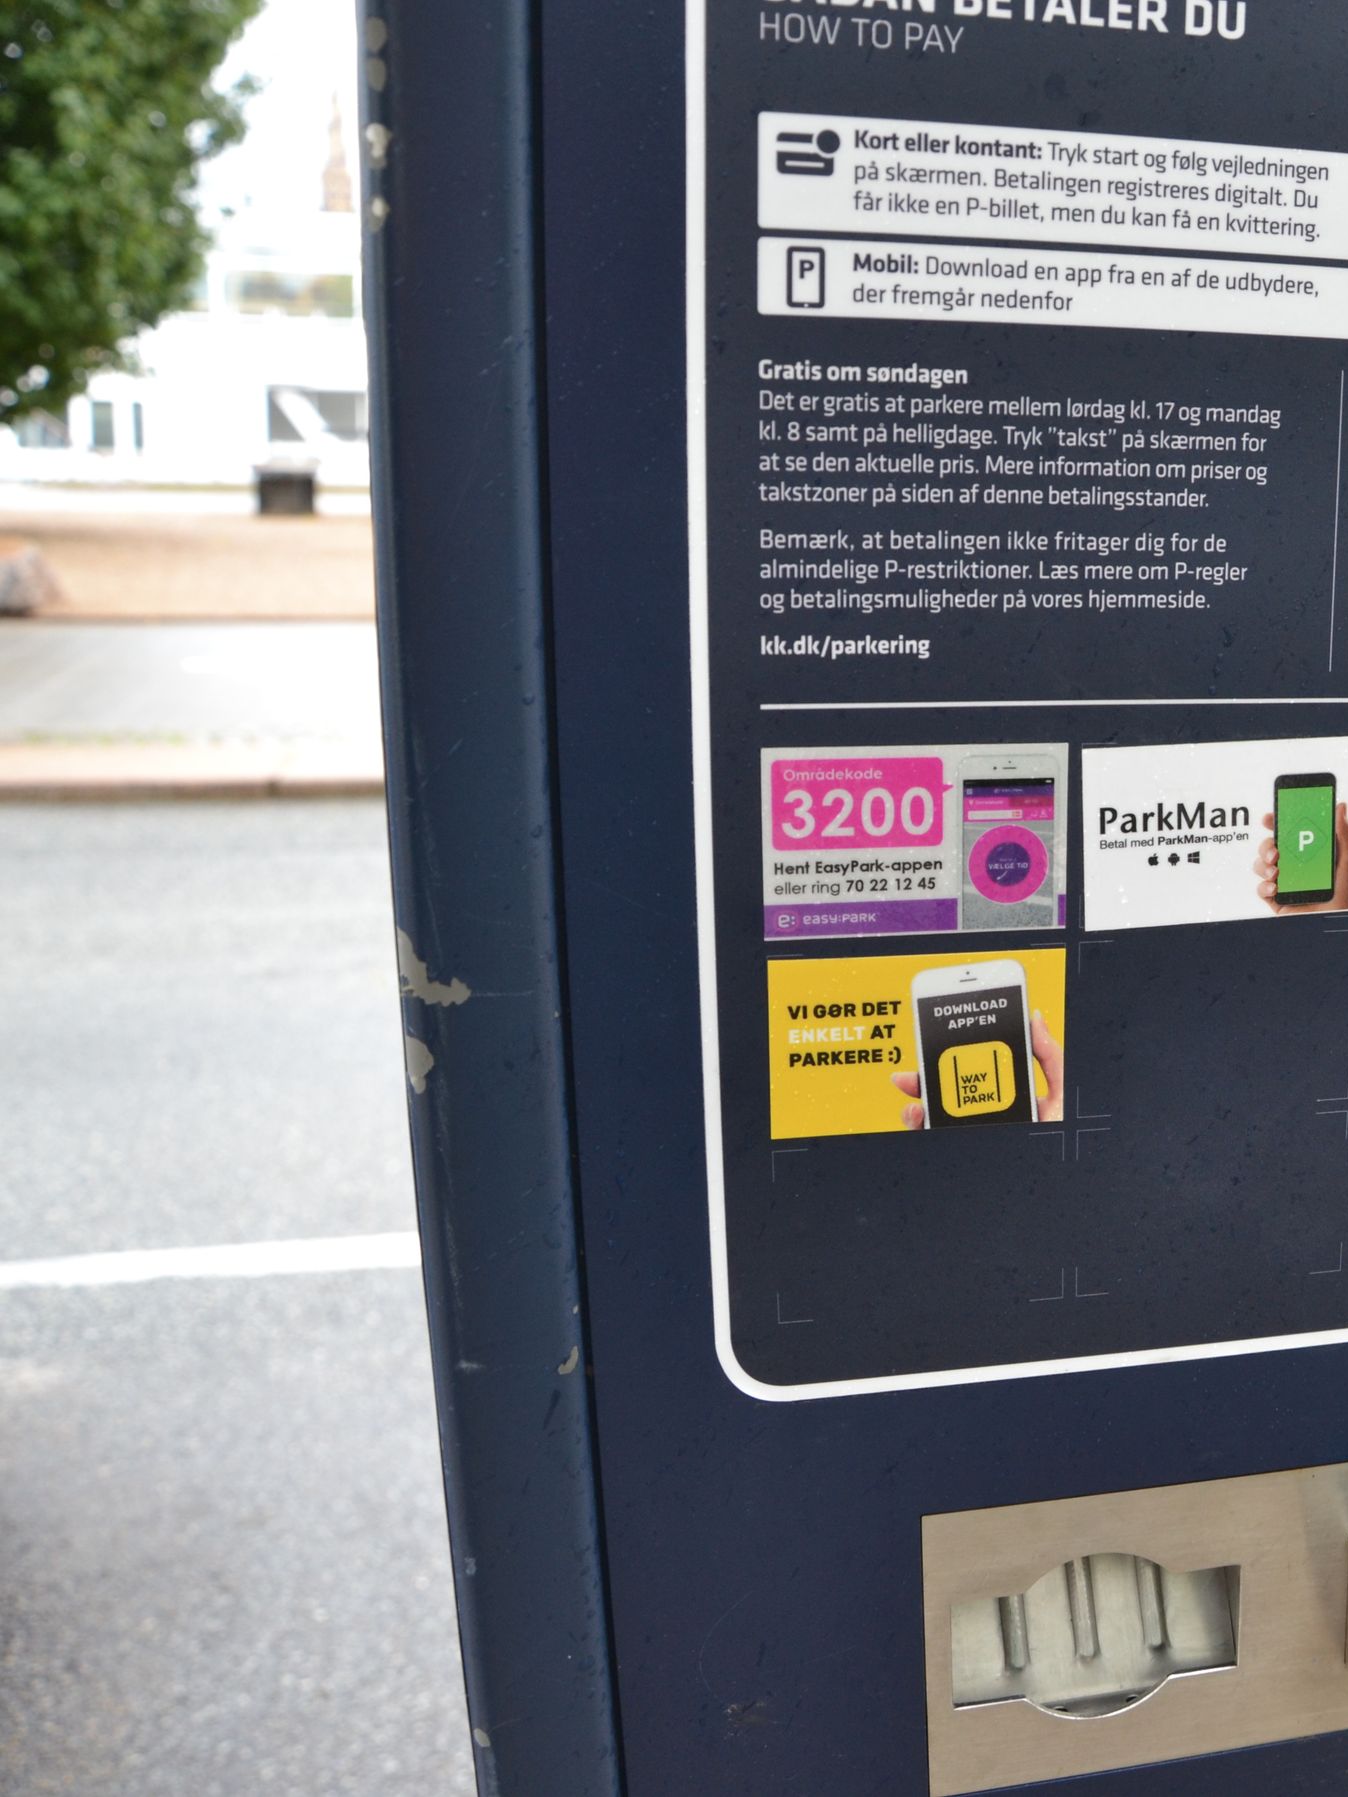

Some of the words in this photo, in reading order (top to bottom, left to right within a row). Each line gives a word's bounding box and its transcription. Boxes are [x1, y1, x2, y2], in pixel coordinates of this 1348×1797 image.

[1184, 0, 1246, 40] DU
[760, 12, 841, 44] HOW
[851, 18, 892, 48] TO
[905, 22, 964, 53] PAY
[855, 130, 899, 150] Kort
[905, 133, 950, 153] eller
[956, 135, 1042, 159] kontant:
[1048, 142, 1087, 166] Tryk
[1094, 148, 1138, 166] start
[1144, 154, 1166, 173] og
[1172, 150, 1207, 176] følg
[1212, 156, 1328, 184] vejledningen
[854, 161, 878, 184] på
[886, 162, 986, 186] skærmen.
[994, 168, 1100, 197] Betalingen
[1108, 178, 1209, 201] registreres
[1215, 184, 1286, 208] digitalt.
[1294, 190, 1318, 208] Du
[854, 190, 882, 210] får
[889, 192, 929, 214] ikke
[936, 200, 959, 215] en
[967, 198, 1044, 222] P-billet,
[1052, 207, 1094, 222] men
[1102, 205, 1125, 224] du
[1132, 207, 1166, 227] kan
[1172, 209, 1190, 228] få
[1197, 216, 1219, 230] en
[1226, 213, 1320, 242] kvittering.
[800, 260, 814, 279] P
[759, 359, 822, 380] Gratis
[827, 366, 861, 381] om
[867, 363, 967, 388] søndagen
[760, 390, 794, 410] Det
[800, 396, 819, 411] er
[824, 392, 879, 416] gratis
[885, 395, 905, 412] at
[911, 394, 983, 418] parkere
[989, 396, 1060, 416] mellem
[1067, 398, 1125, 423] lørdag
[1130, 400, 1150, 419] kl.
[1156, 402, 1174, 420] 17
[1179, 407, 1201, 426] og
[1206, 405, 1280, 429] mandag
[760, 529, 854, 551] Bemærk,
[862, 532, 883, 549] at
[890, 530, 1000, 554] betalingen
[1008, 531, 1048, 550] ikke
[1054, 531, 1129, 556] fritager
[1136, 533, 1164, 556] dig
[1171, 533, 1198, 552] for
[1204, 534, 1226, 552] de
[760, 559, 878, 584] almindelige
[886, 560, 1032, 579] P-restriktioner.
[1040, 561, 1078, 579] Læs
[1085, 566, 1132, 579] mere
[1138, 566, 1168, 580] om
[1175, 562, 1248, 585] P-regler
[760, 594, 784, 614] og
[791, 588, 998, 613] betalingsmuligheder
[1004, 590, 1026, 612] på
[1032, 594, 1082, 608] vores
[1089, 590, 1210, 612] hjemmeside.
[761, 635, 930, 659] kk.dk/parkering
[783, 768, 883, 781] Områdekode
[782, 787, 934, 839] 3200
[1100, 802, 1250, 835] ParkMan
[1100, 839, 1127, 849] Betal
[1131, 837, 1154, 848] med
[1299, 831, 1314, 851] P
[774, 861, 810, 875] Hent
[816, 858, 943, 876] EasyPark-appen
[774, 880, 808, 895] eller
[812, 880, 840, 894] ring
[846, 880, 863, 892] 70
[870, 879, 888, 891] 22
[895, 878, 911, 891] 12
[917, 877, 935, 890] 45
[788, 1005, 807, 1020] VI
[813, 1003, 856, 1019] GØR
[863, 1001, 901, 1015] DET
[934, 998, 1008, 1017] DOWNLOAD
[788, 1026, 864, 1044] ENKELT
[870, 1024, 895, 1040] AT
[789, 1049, 882, 1067] PARKERE
[961, 1073, 987, 1084] WAY
[962, 1085, 977, 1094] TO
[963, 1093, 995, 1104] PARK
